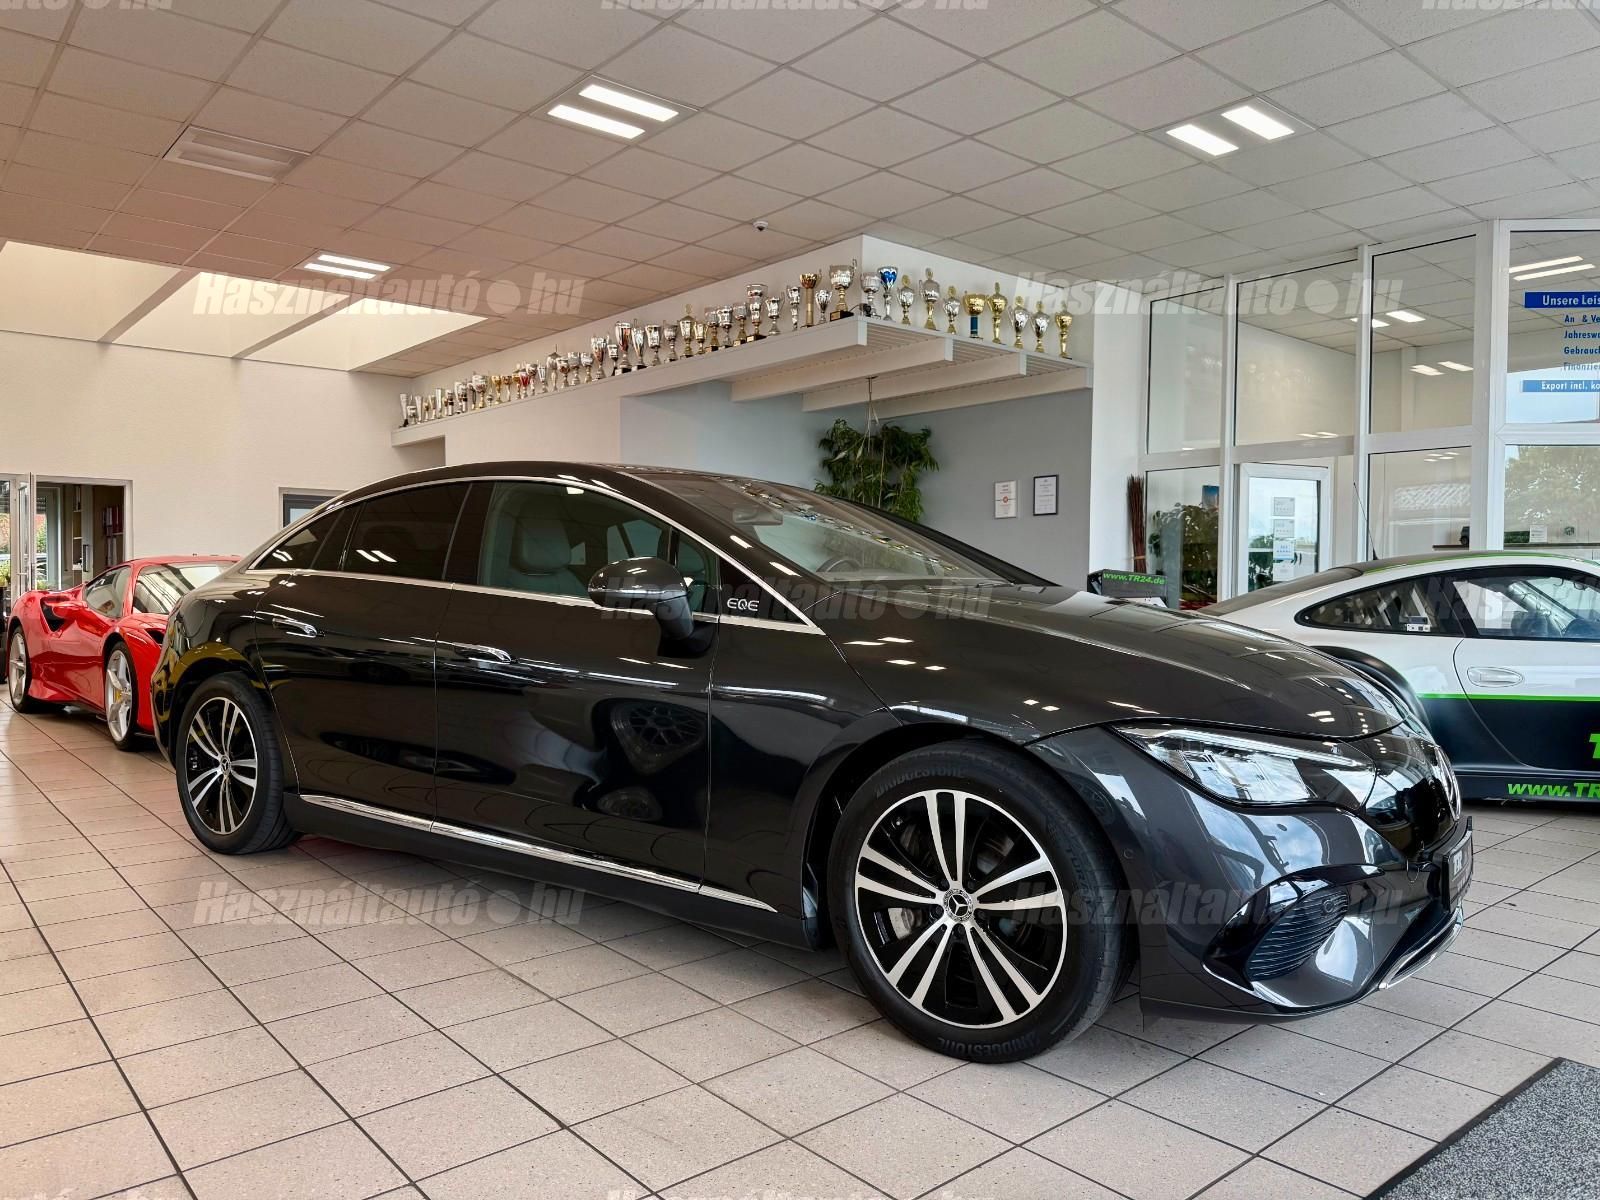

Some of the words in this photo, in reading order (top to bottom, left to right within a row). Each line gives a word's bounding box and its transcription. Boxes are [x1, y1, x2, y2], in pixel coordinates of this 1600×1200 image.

[1542, 295, 1579, 306] Unsere
[1541, 381, 1567, 391] Export
[1103, 572, 1166, 585] www.TR24.de
[727, 597, 760, 611] EQE
